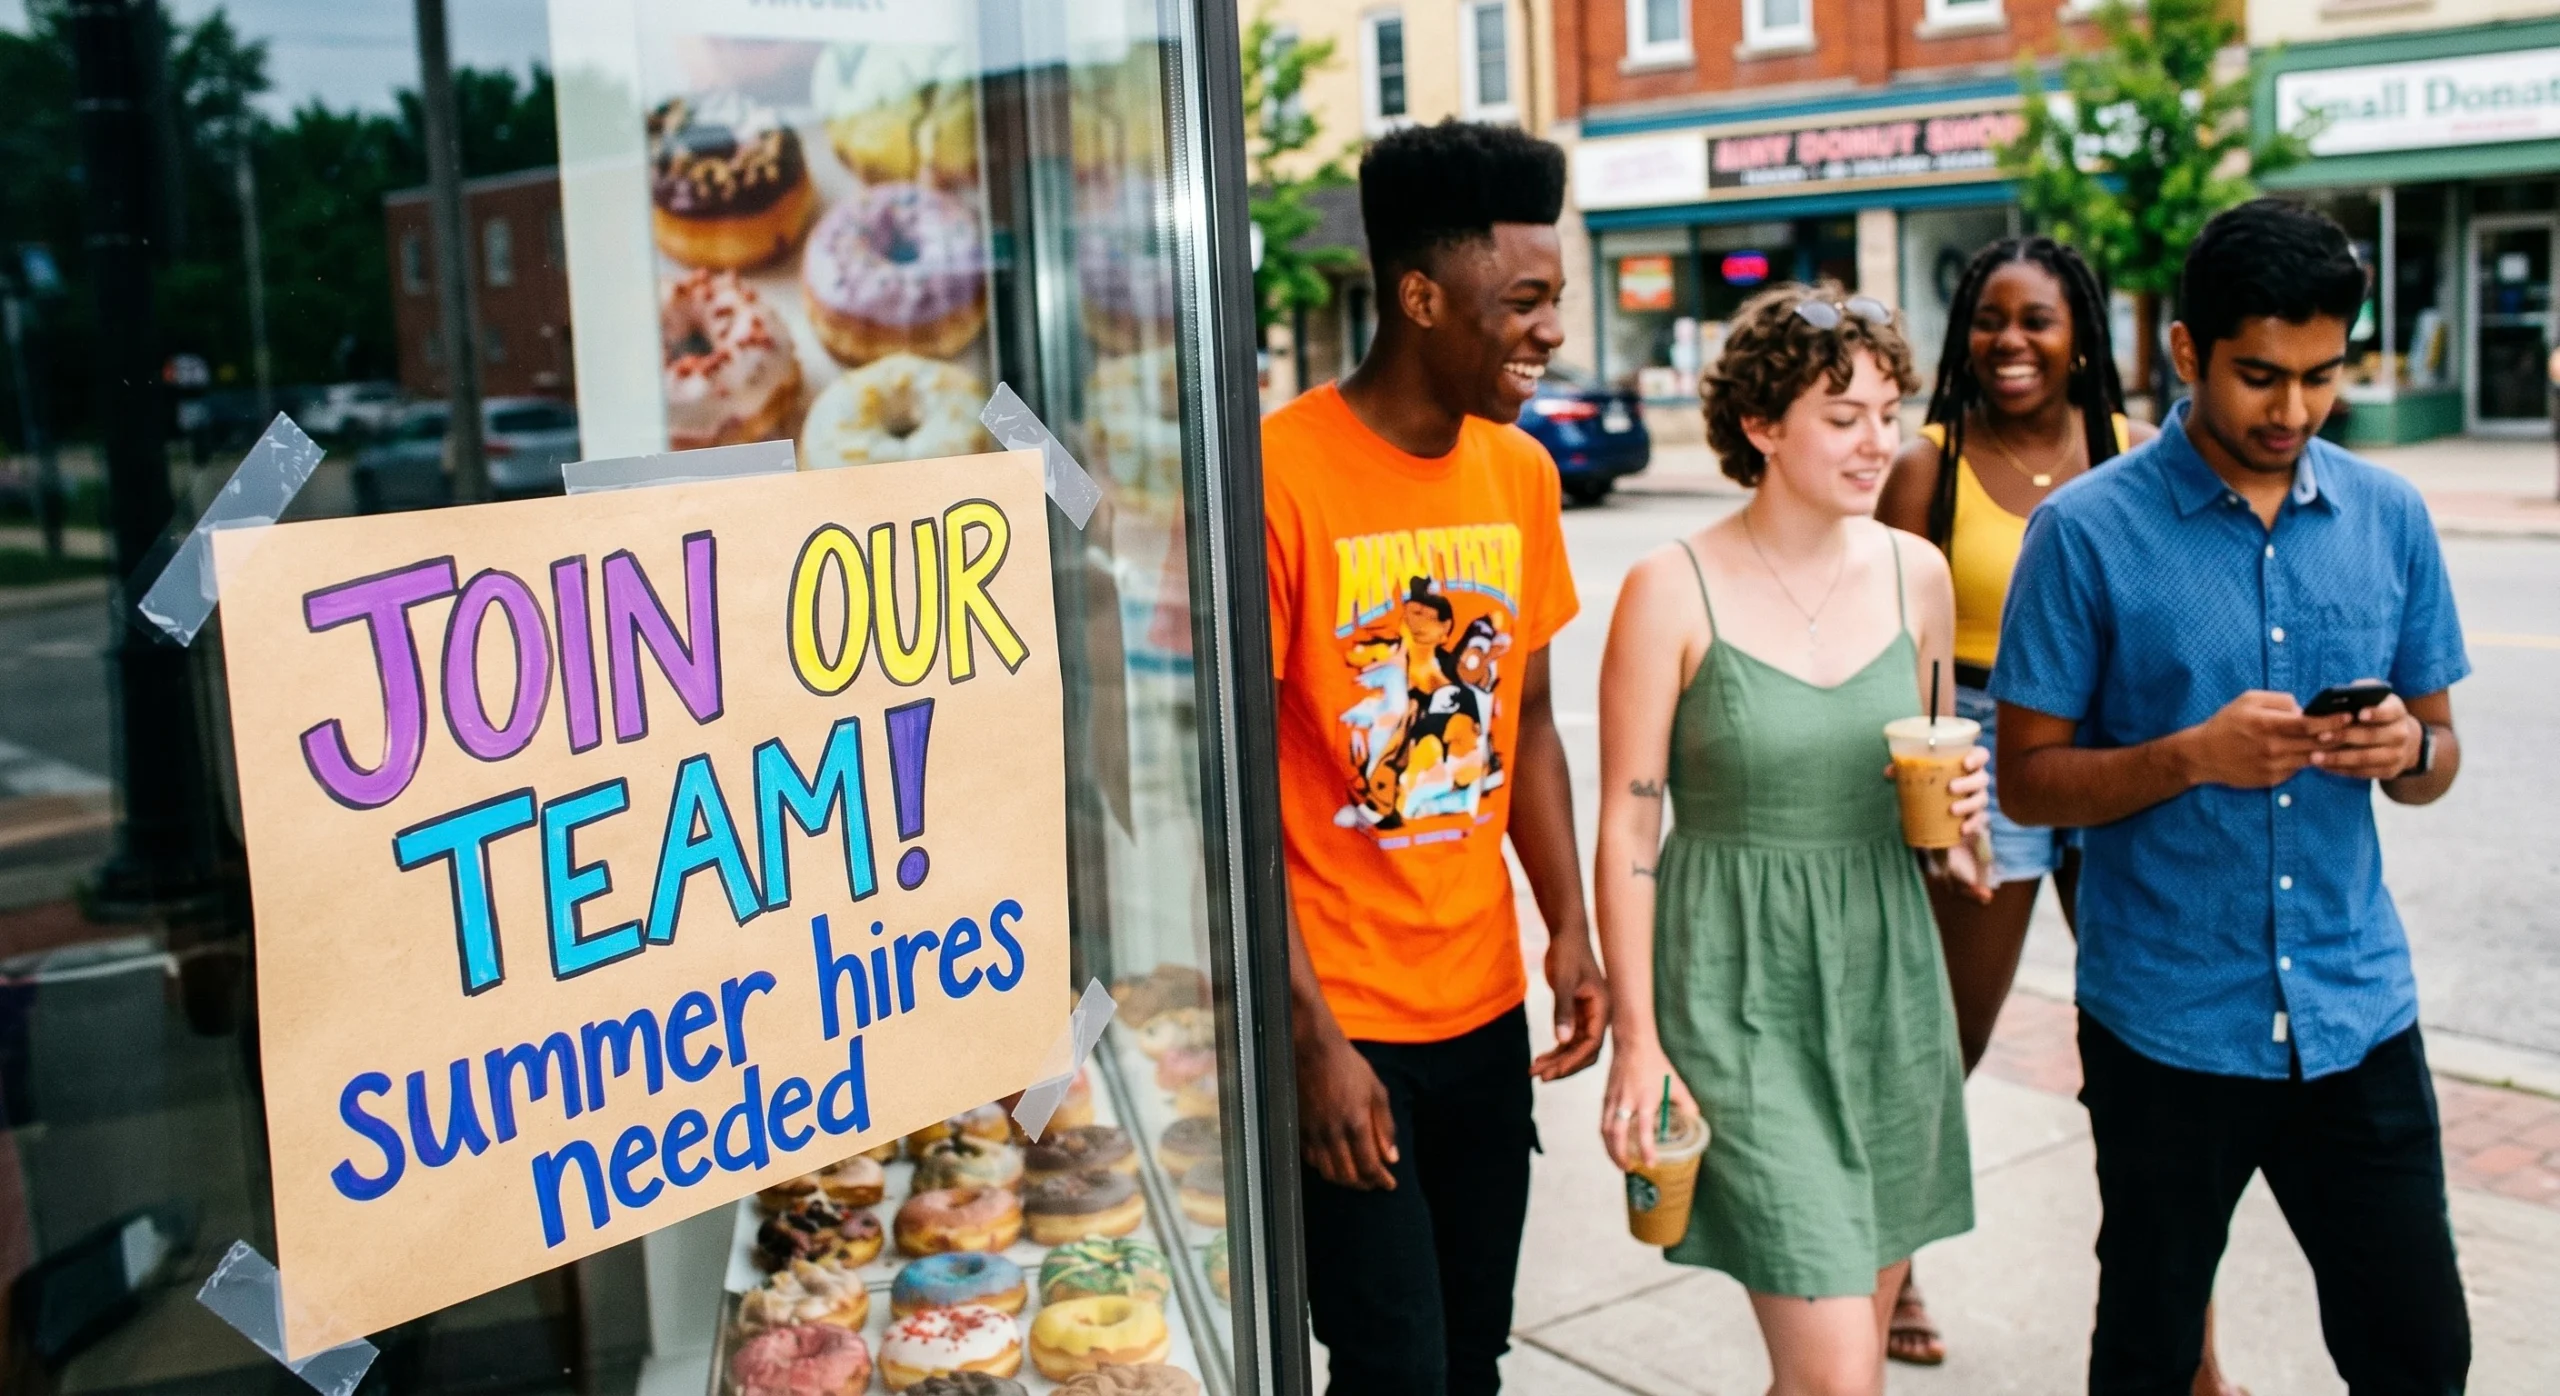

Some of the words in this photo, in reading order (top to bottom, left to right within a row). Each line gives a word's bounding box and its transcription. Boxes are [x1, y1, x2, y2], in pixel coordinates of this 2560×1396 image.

[300, 530, 722, 811] JOIN
[787, 498, 1030, 696] OUR
[392, 697, 935, 997] TEAM!
[330, 969, 777, 1202] summer
[811, 898, 1027, 1040] hires
[530, 1036, 872, 1250] needed
